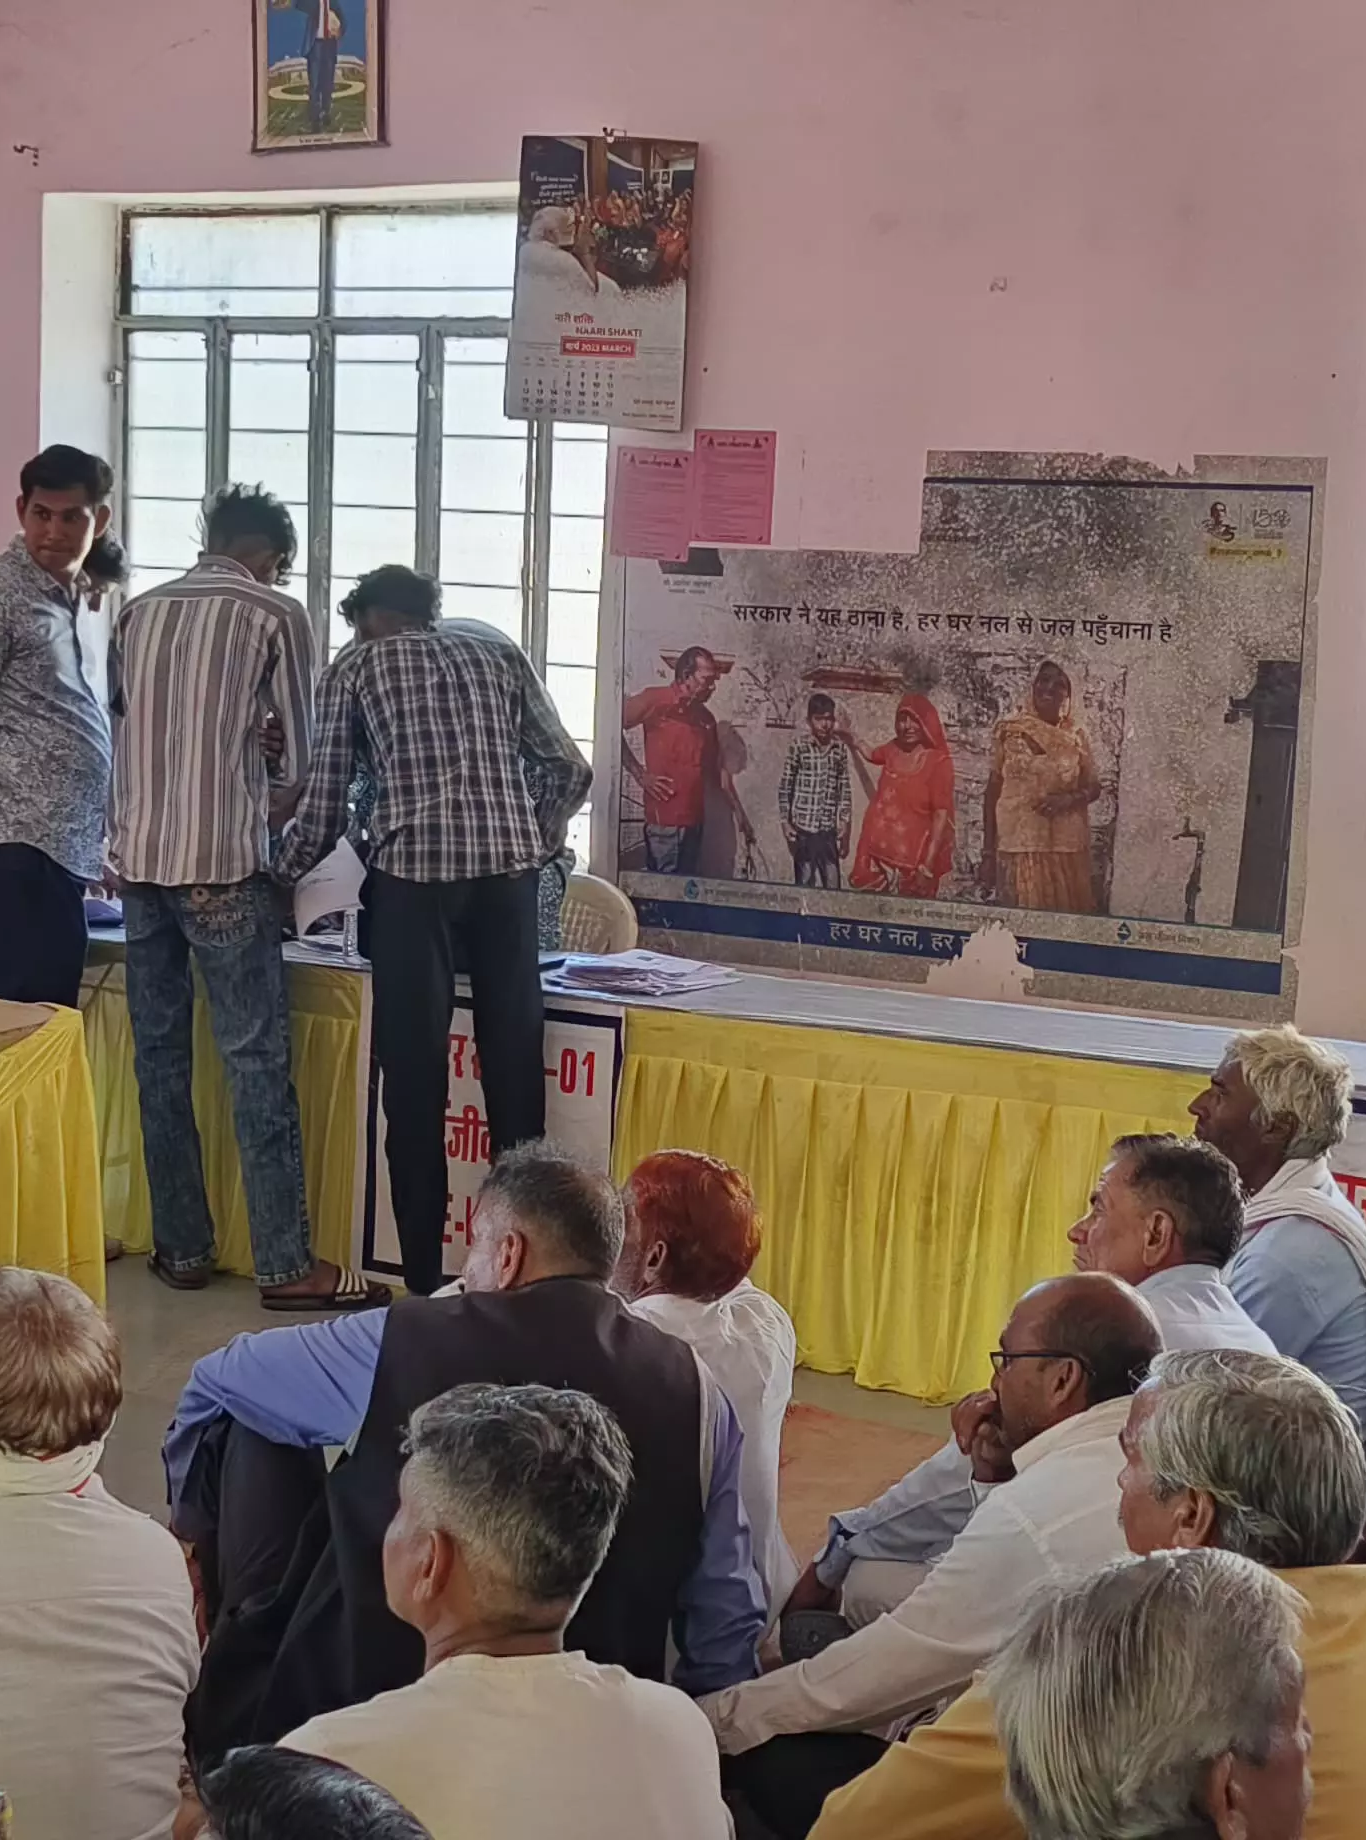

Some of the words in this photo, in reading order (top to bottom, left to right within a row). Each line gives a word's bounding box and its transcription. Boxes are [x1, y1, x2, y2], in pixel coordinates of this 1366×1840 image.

[607, 327, 643, 337] SHAKTI
[733, 603, 792, 624] सरकार
[797, 601, 811, 624] ने
[816, 607, 841, 627] यह
[847, 608, 885, 628] ठाना
[917, 611, 941, 631] हर
[947, 612, 974, 632] घर
[980, 614, 1010, 634] नल
[1016, 610, 1033, 635] से
[1039, 616, 1076, 637] जल
[1082, 612, 1153, 645] पहुँचाना
[1158, 617, 1173, 643] है
[829, 921, 852, 941] हर
[858, 924, 882, 943] घर
[930, 931, 956, 952] हर
